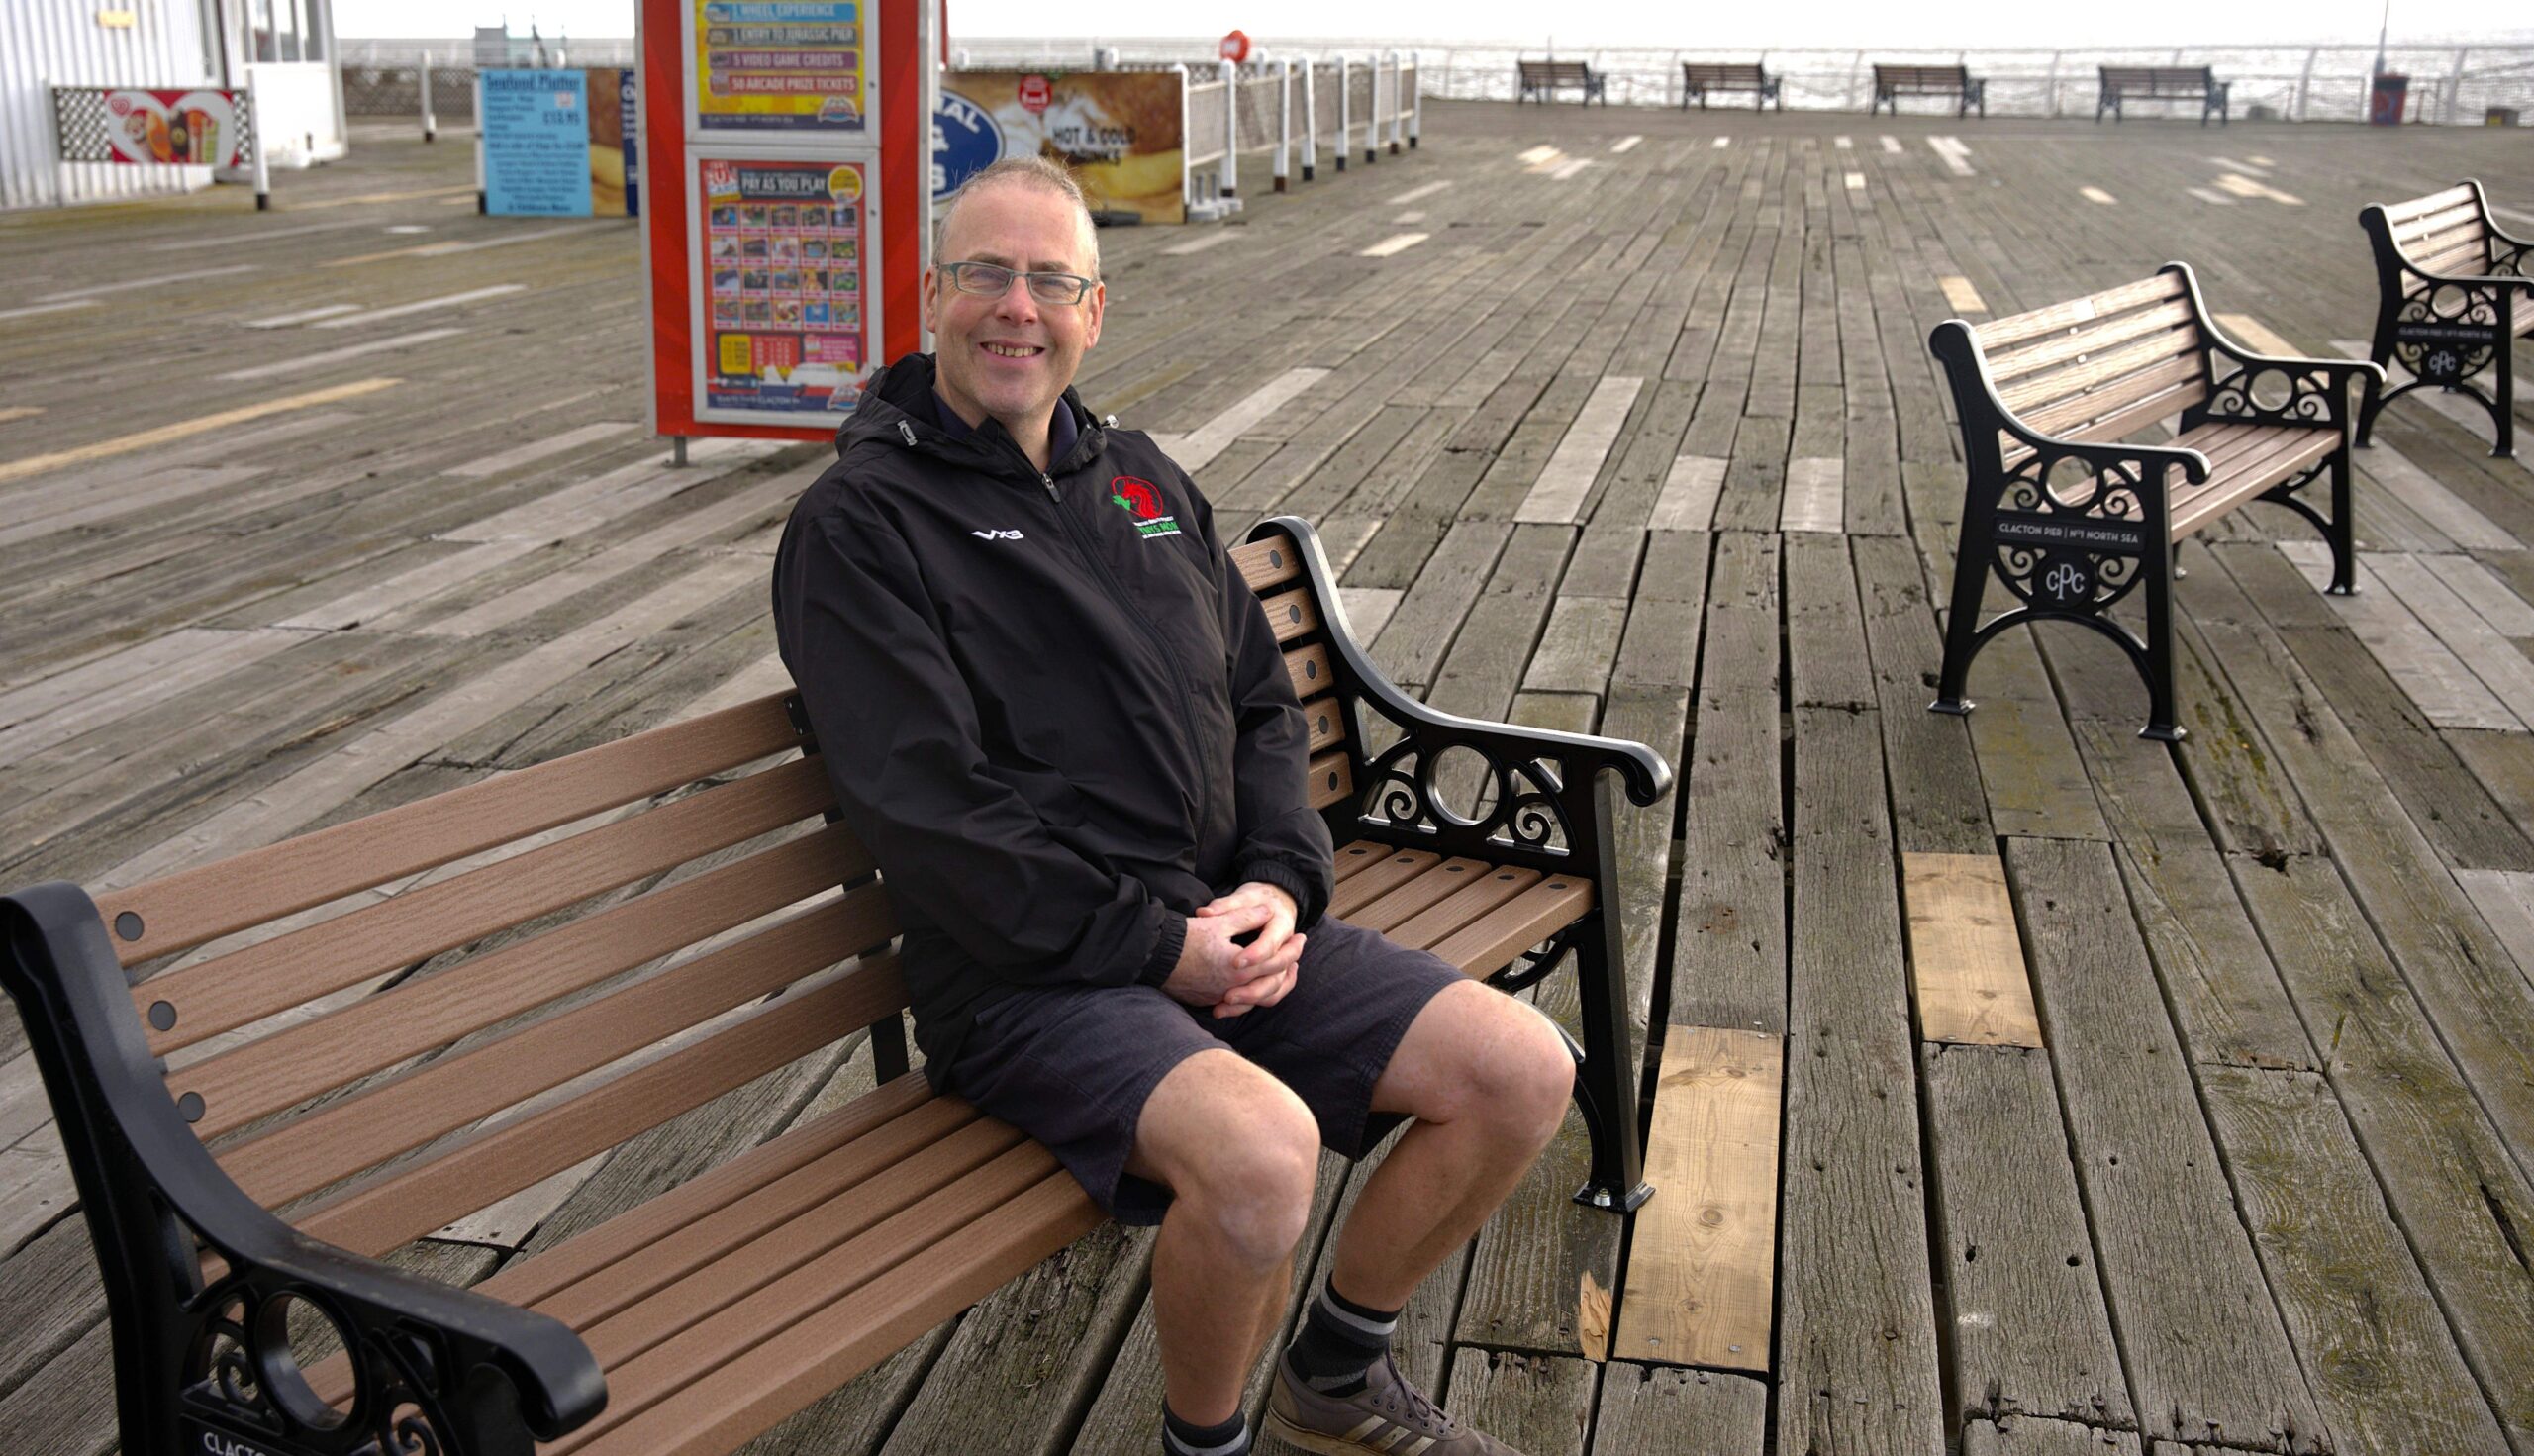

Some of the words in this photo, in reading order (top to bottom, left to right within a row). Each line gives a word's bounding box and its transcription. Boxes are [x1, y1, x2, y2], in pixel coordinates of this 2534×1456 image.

[740, 4, 774, 16] WHEEL
[778, 4, 835, 17] EXPERIENCE
[740, 28, 769, 41] ENTRY
[771, 28, 783, 42] TO
[785, 28, 829, 42] JURASSIC
[831, 27, 854, 41] PIER
[743, 53, 771, 66] VIDEO
[774, 54, 800, 66] GAME
[803, 53, 843, 67] CREDITS
[486, 74, 536, 91] Seafood
[538, 74, 580, 91] Platter
[732, 77, 745, 90] 50
[747, 77, 784, 91] ARCADE
[787, 77, 814, 91] PRIZE
[816, 77, 855, 91] TICKETS
[1052, 127, 1081, 145] HOT
[1087, 127, 1096, 145] &
[1100, 127, 1136, 145] COLD
[742, 177, 760, 191] PAY
[762, 178, 776, 190] AS
[778, 178, 798, 191] YOU
[801, 178, 827, 191] PLAY
[1999, 523, 2042, 535] CLACTON
[2044, 526, 2063, 537] PIER
[2086, 530, 2118, 542] NORTH
[2120, 533, 2138, 543] SEA
[2045, 563, 2085, 600] CPC
